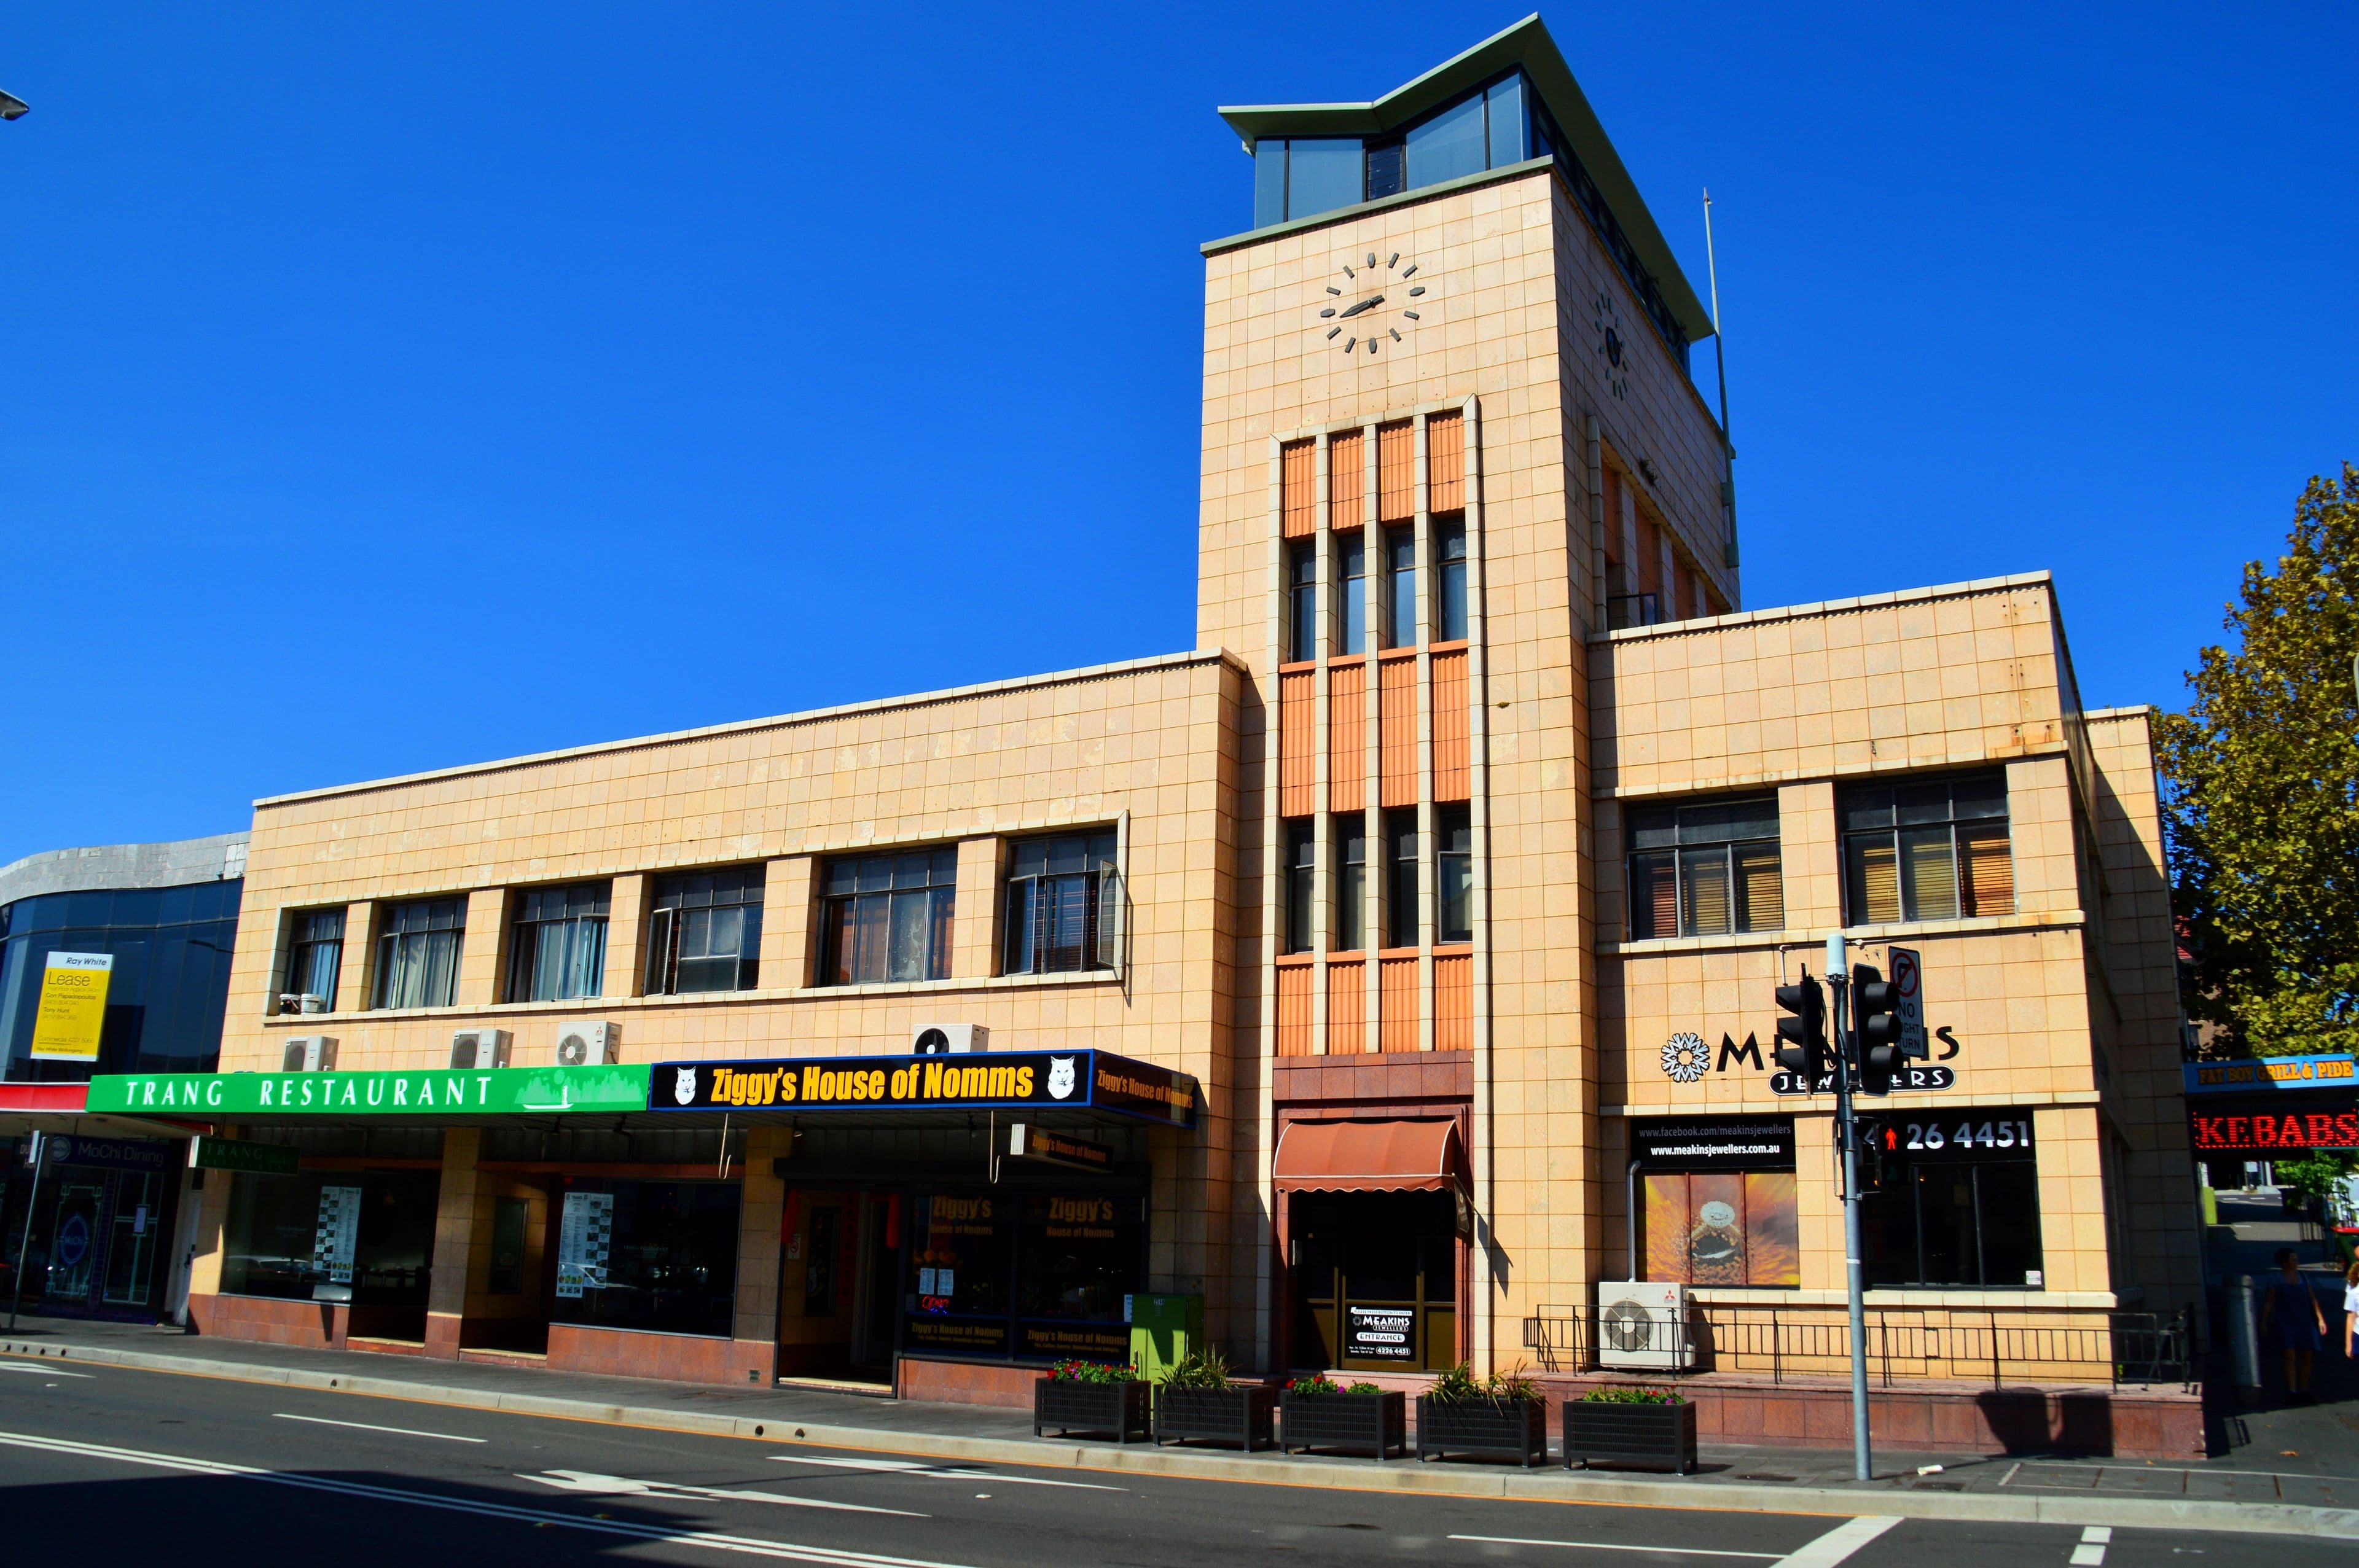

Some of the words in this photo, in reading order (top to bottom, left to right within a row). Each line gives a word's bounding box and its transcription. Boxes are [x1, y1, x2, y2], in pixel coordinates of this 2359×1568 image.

[48, 972, 90, 986] Lease
[1898, 1002, 1915, 1018] NO
[2198, 1068, 2224, 1085] FAT
[2226, 1066, 2254, 1083] BOY
[2256, 1063, 2301, 1082] GRILL
[2302, 1061, 2313, 1079] &
[2315, 1059, 2353, 1078] PIDE
[127, 1080, 223, 1106] TRANG
[260, 1077, 491, 1106] RESTAURANT
[711, 1067, 797, 1106] Ziggy's
[802, 1066, 885, 1101] House
[891, 1064, 920, 1099] of
[924, 1063, 1033, 1098] Nomms
[1097, 1069, 1127, 1093] Ziggy's
[1129, 1078, 1154, 1099] House
[1156, 1086, 1164, 1101] of
[1165, 1087, 1193, 1109] Nomms
[1639, 1124, 1791, 1137] www.facebook.com/meakinsjewellers
[1954, 1121, 2028, 1148] 4451
[2199, 1114, 2359, 1144] KEBABS
[78, 1142, 121, 1159] MoChi
[125, 1146, 164, 1166] Dining
[206, 1143, 263, 1160] TRANG
[1032, 1135, 1055, 1152] Ziggy's
[1055, 1140, 1076, 1155] House
[1076, 1145, 1082, 1156] of
[1083, 1145, 1106, 1163] Nomms
[1651, 1144, 1780, 1157] www.meakinsjewellers.com.au
[933, 1196, 992, 1220] Ziggy's
[1049, 1198, 1114, 1222] Ziggy's
[963, 1224, 993, 1236] Nomms
[1046, 1227, 1071, 1238] House
[1073, 1227, 1082, 1237] of
[1082, 1228, 1114, 1238] Nomms
[911, 1322, 937, 1334] Ziggy's
[939, 1323, 963, 1335] House
[964, 1325, 972, 1336] of
[1363, 1316, 1410, 1326] MEAKINS
[1027, 1329, 1055, 1341] Ziggy's
[1057, 1331, 1083, 1343] House
[1085, 1332, 1093, 1343] of
[1095, 1333, 1128, 1346] Nomms
